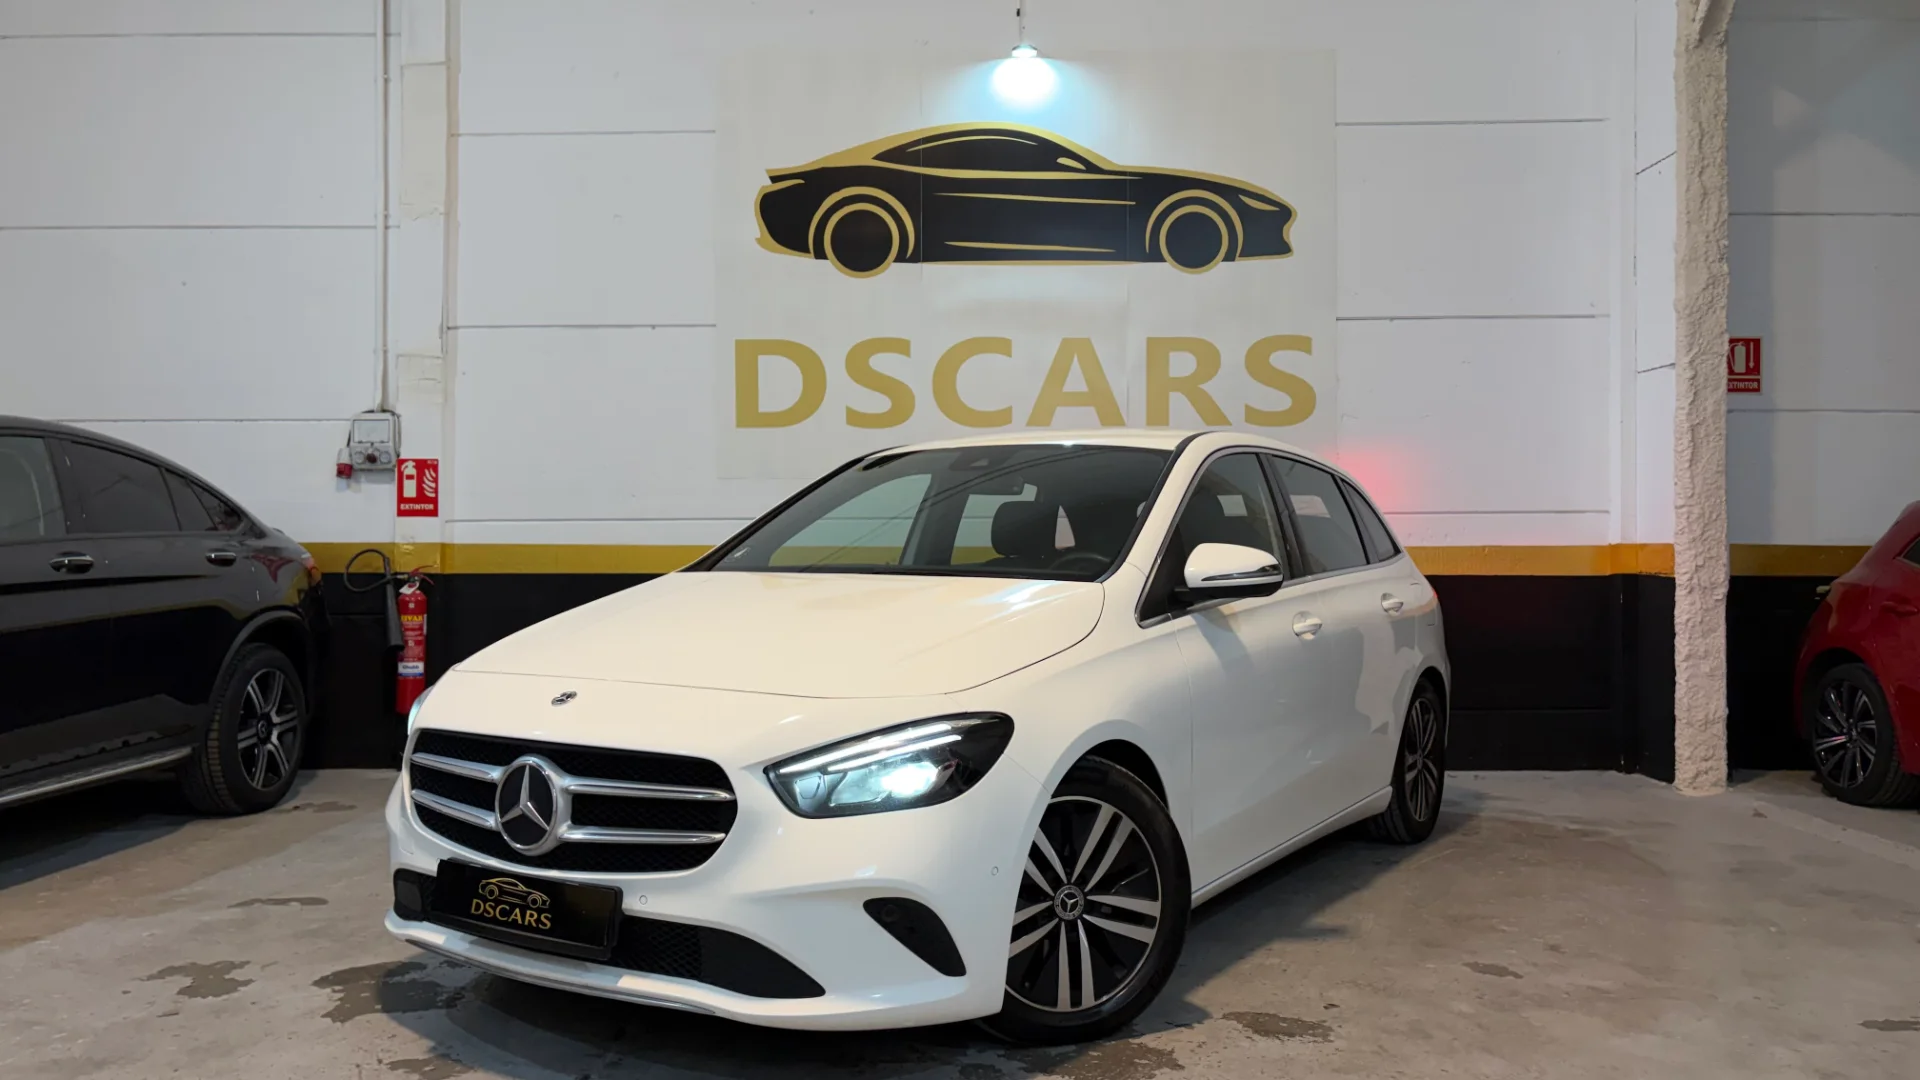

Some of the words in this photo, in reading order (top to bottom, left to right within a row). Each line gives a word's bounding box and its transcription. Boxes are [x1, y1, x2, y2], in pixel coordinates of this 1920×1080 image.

[734, 335, 1317, 429] DSCARS
[400, 503, 434, 511] EXTINTOR
[471, 898, 552, 929] DSCARS
